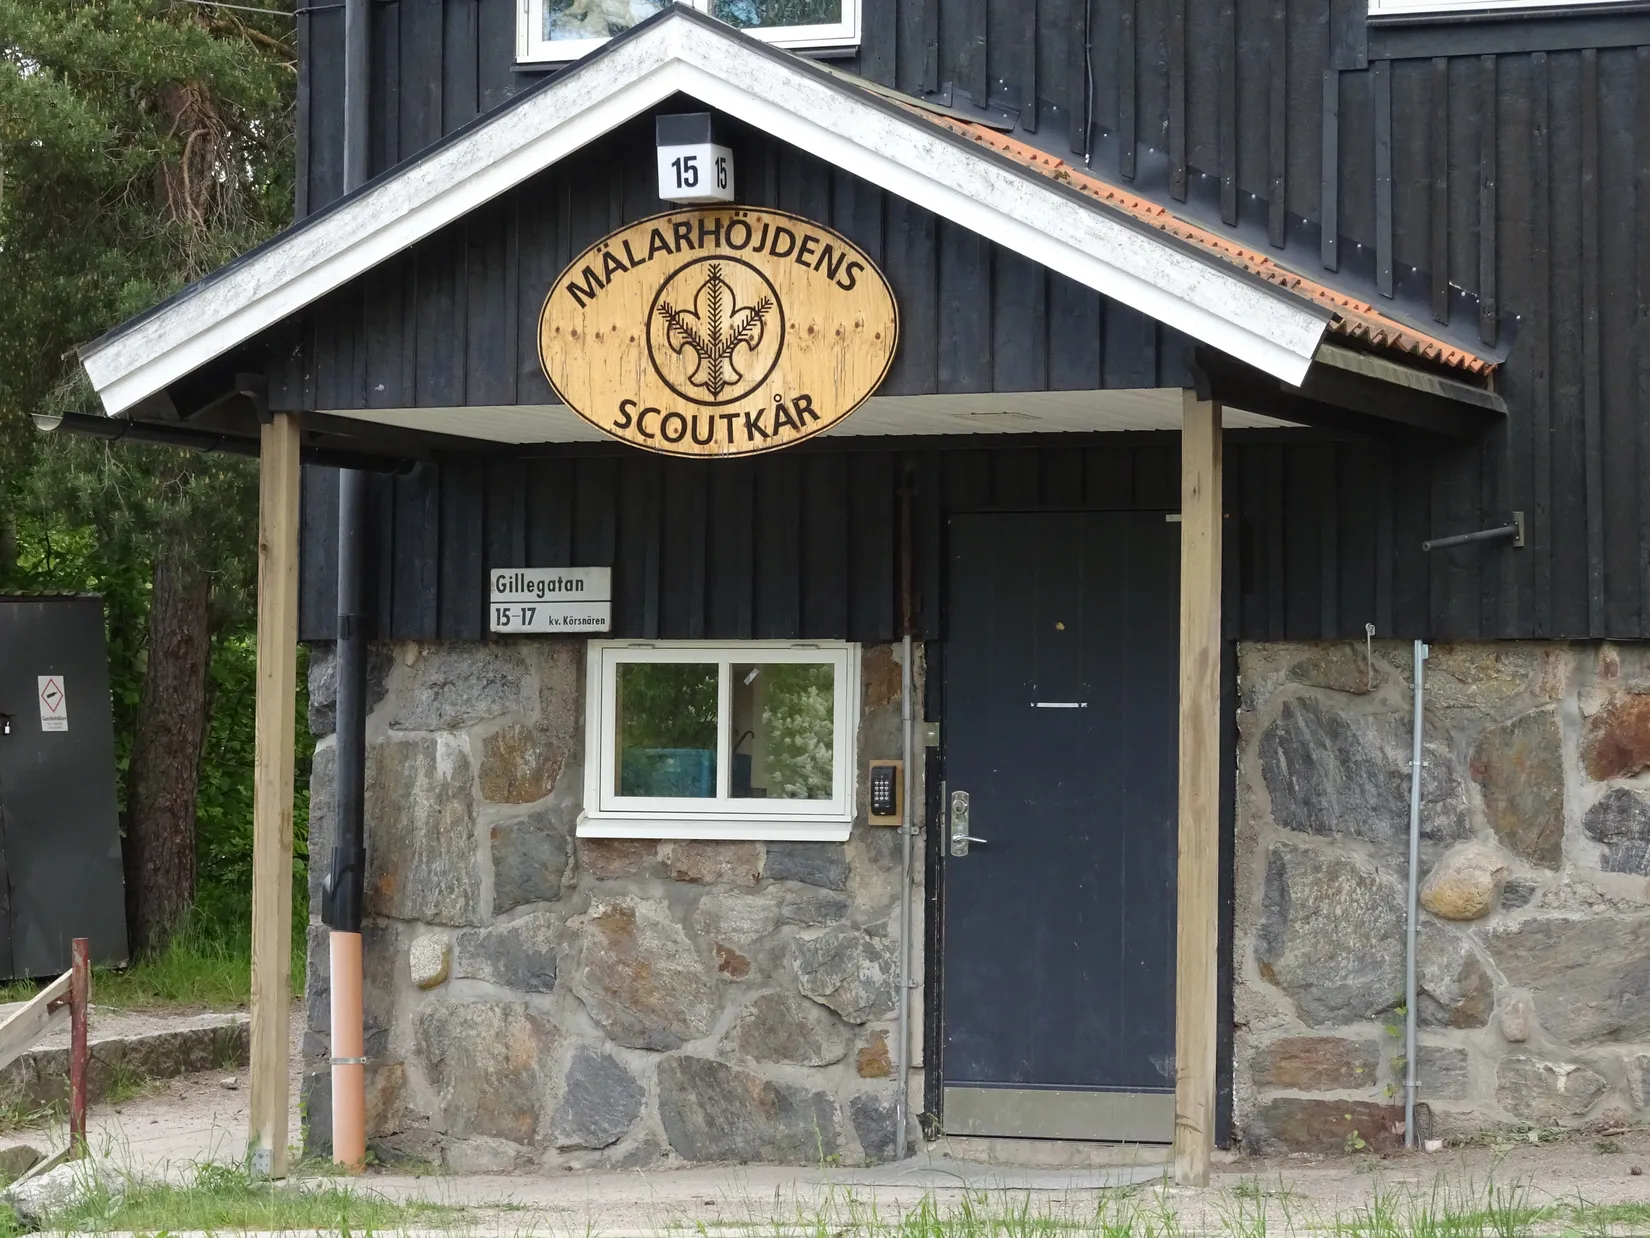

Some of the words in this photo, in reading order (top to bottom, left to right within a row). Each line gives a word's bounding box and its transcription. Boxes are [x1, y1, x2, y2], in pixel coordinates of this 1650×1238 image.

[671, 155, 699, 189] 15
[715, 156, 727, 190] 15
[565, 211, 865, 309] MÄLARHÖJDENS
[613, 393, 821, 446] SCOUTKÅR
[495, 573, 584, 599] Gillegatan
[548, 615, 561, 626] kv.
[563, 615, 606, 626] Körsnären
